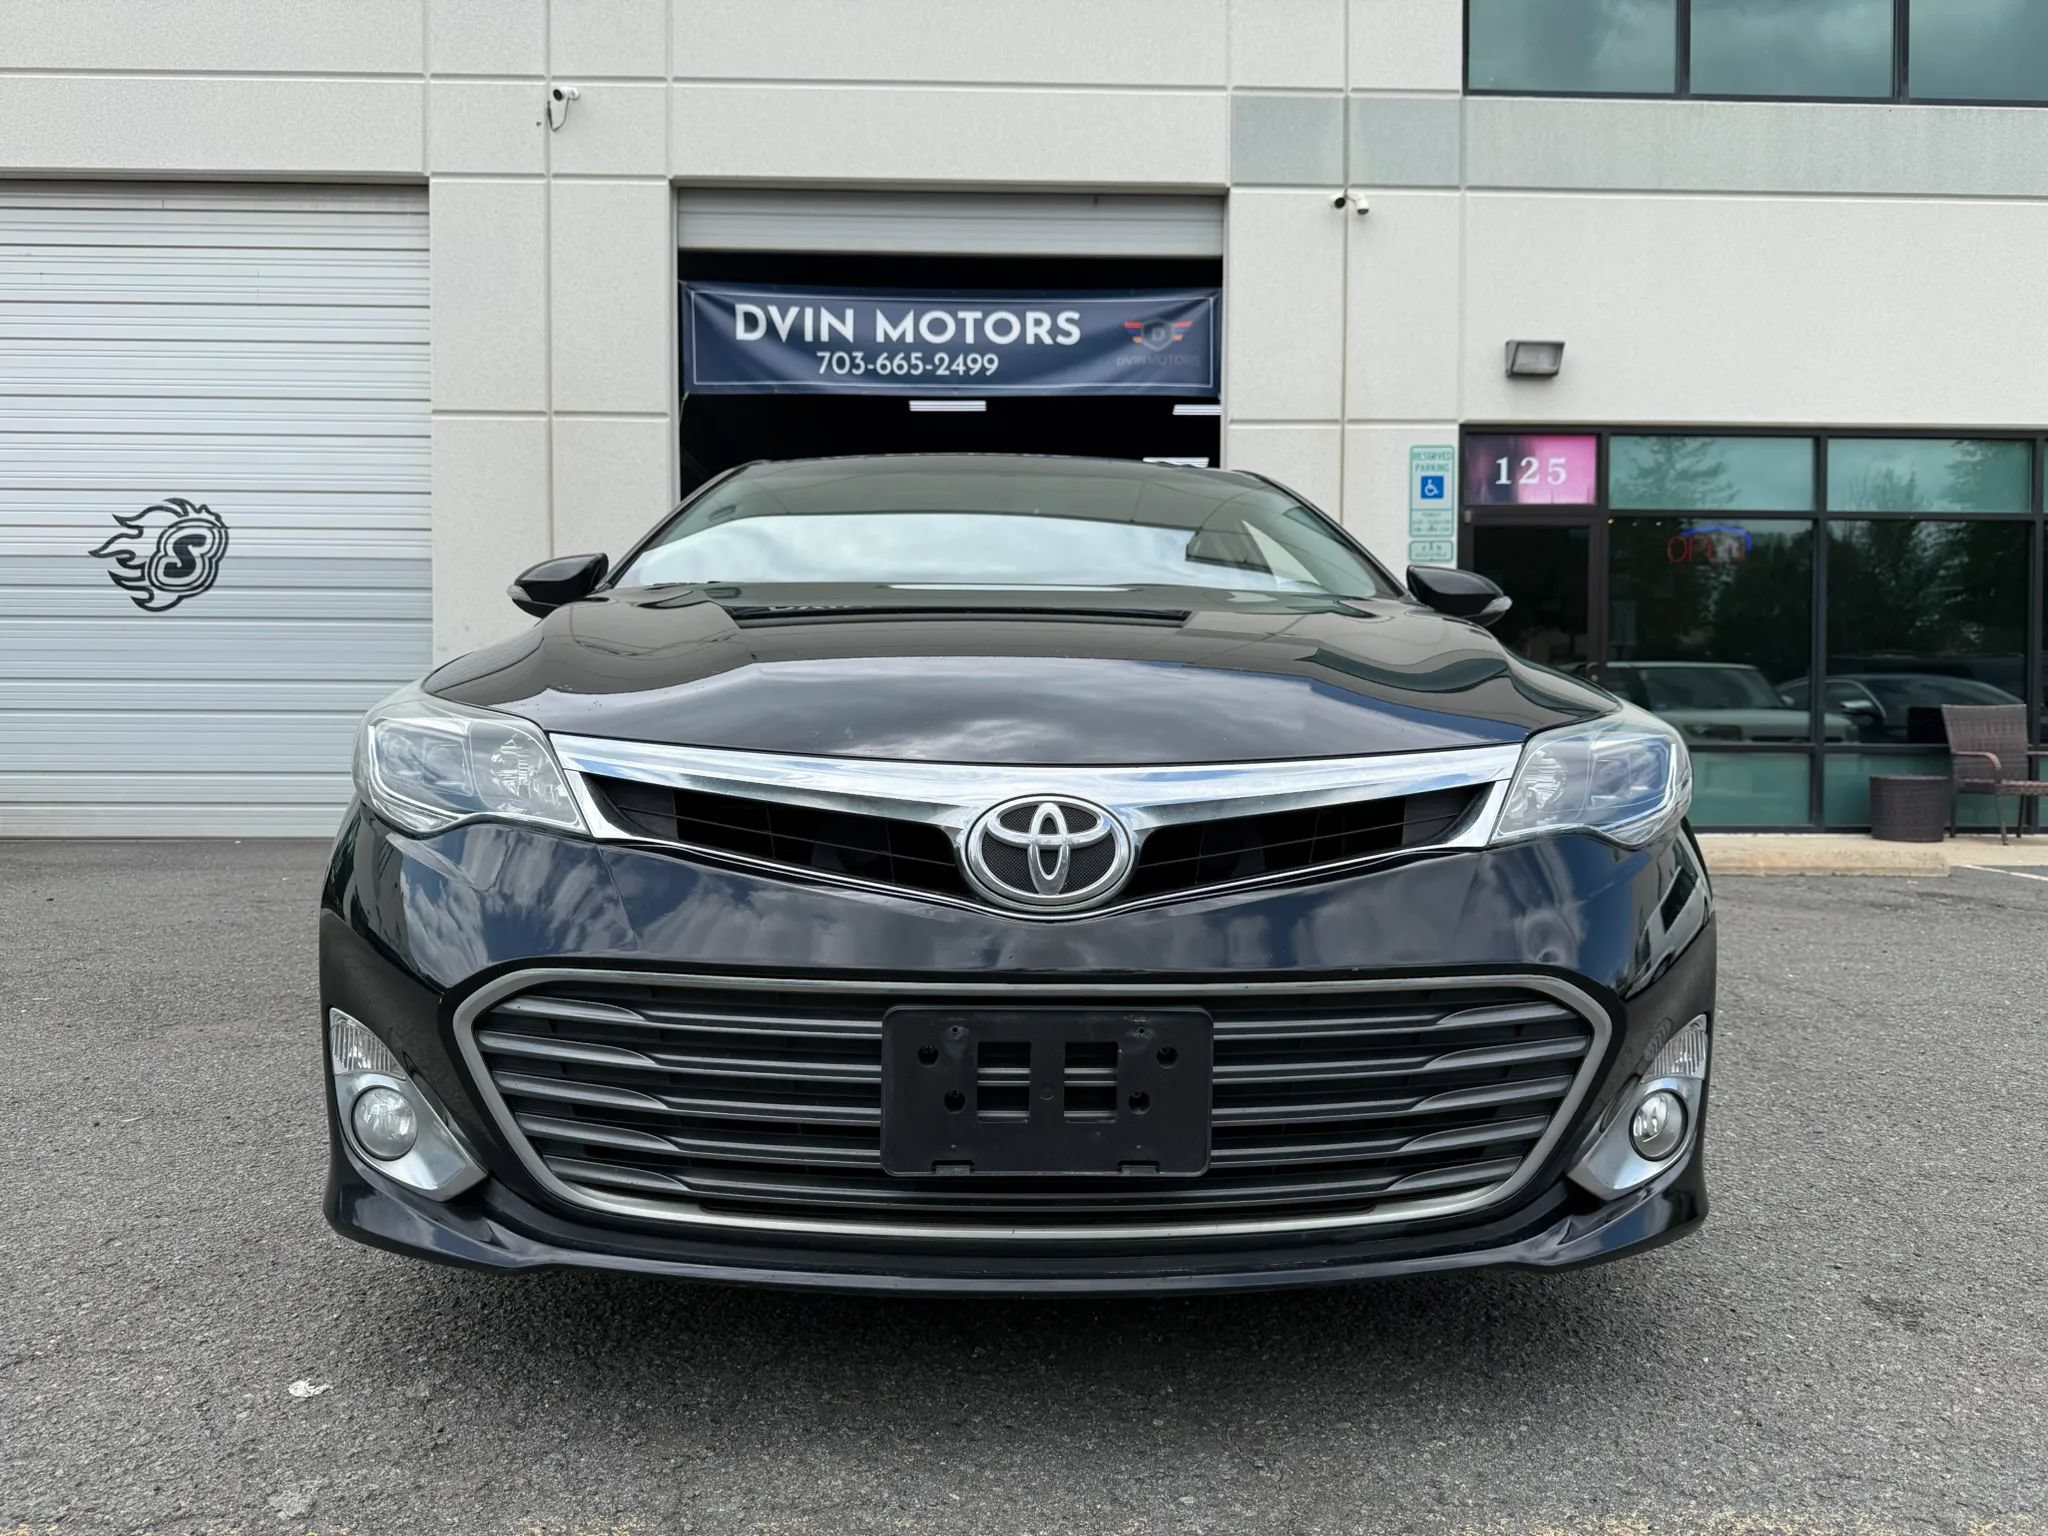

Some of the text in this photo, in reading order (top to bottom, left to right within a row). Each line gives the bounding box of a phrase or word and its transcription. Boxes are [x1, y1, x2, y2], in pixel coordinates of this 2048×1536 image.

[734, 303, 1081, 346] DVIN MOTORS
[816, 350, 999, 376] 703-665-2499
[1495, 456, 1567, 485] 125
